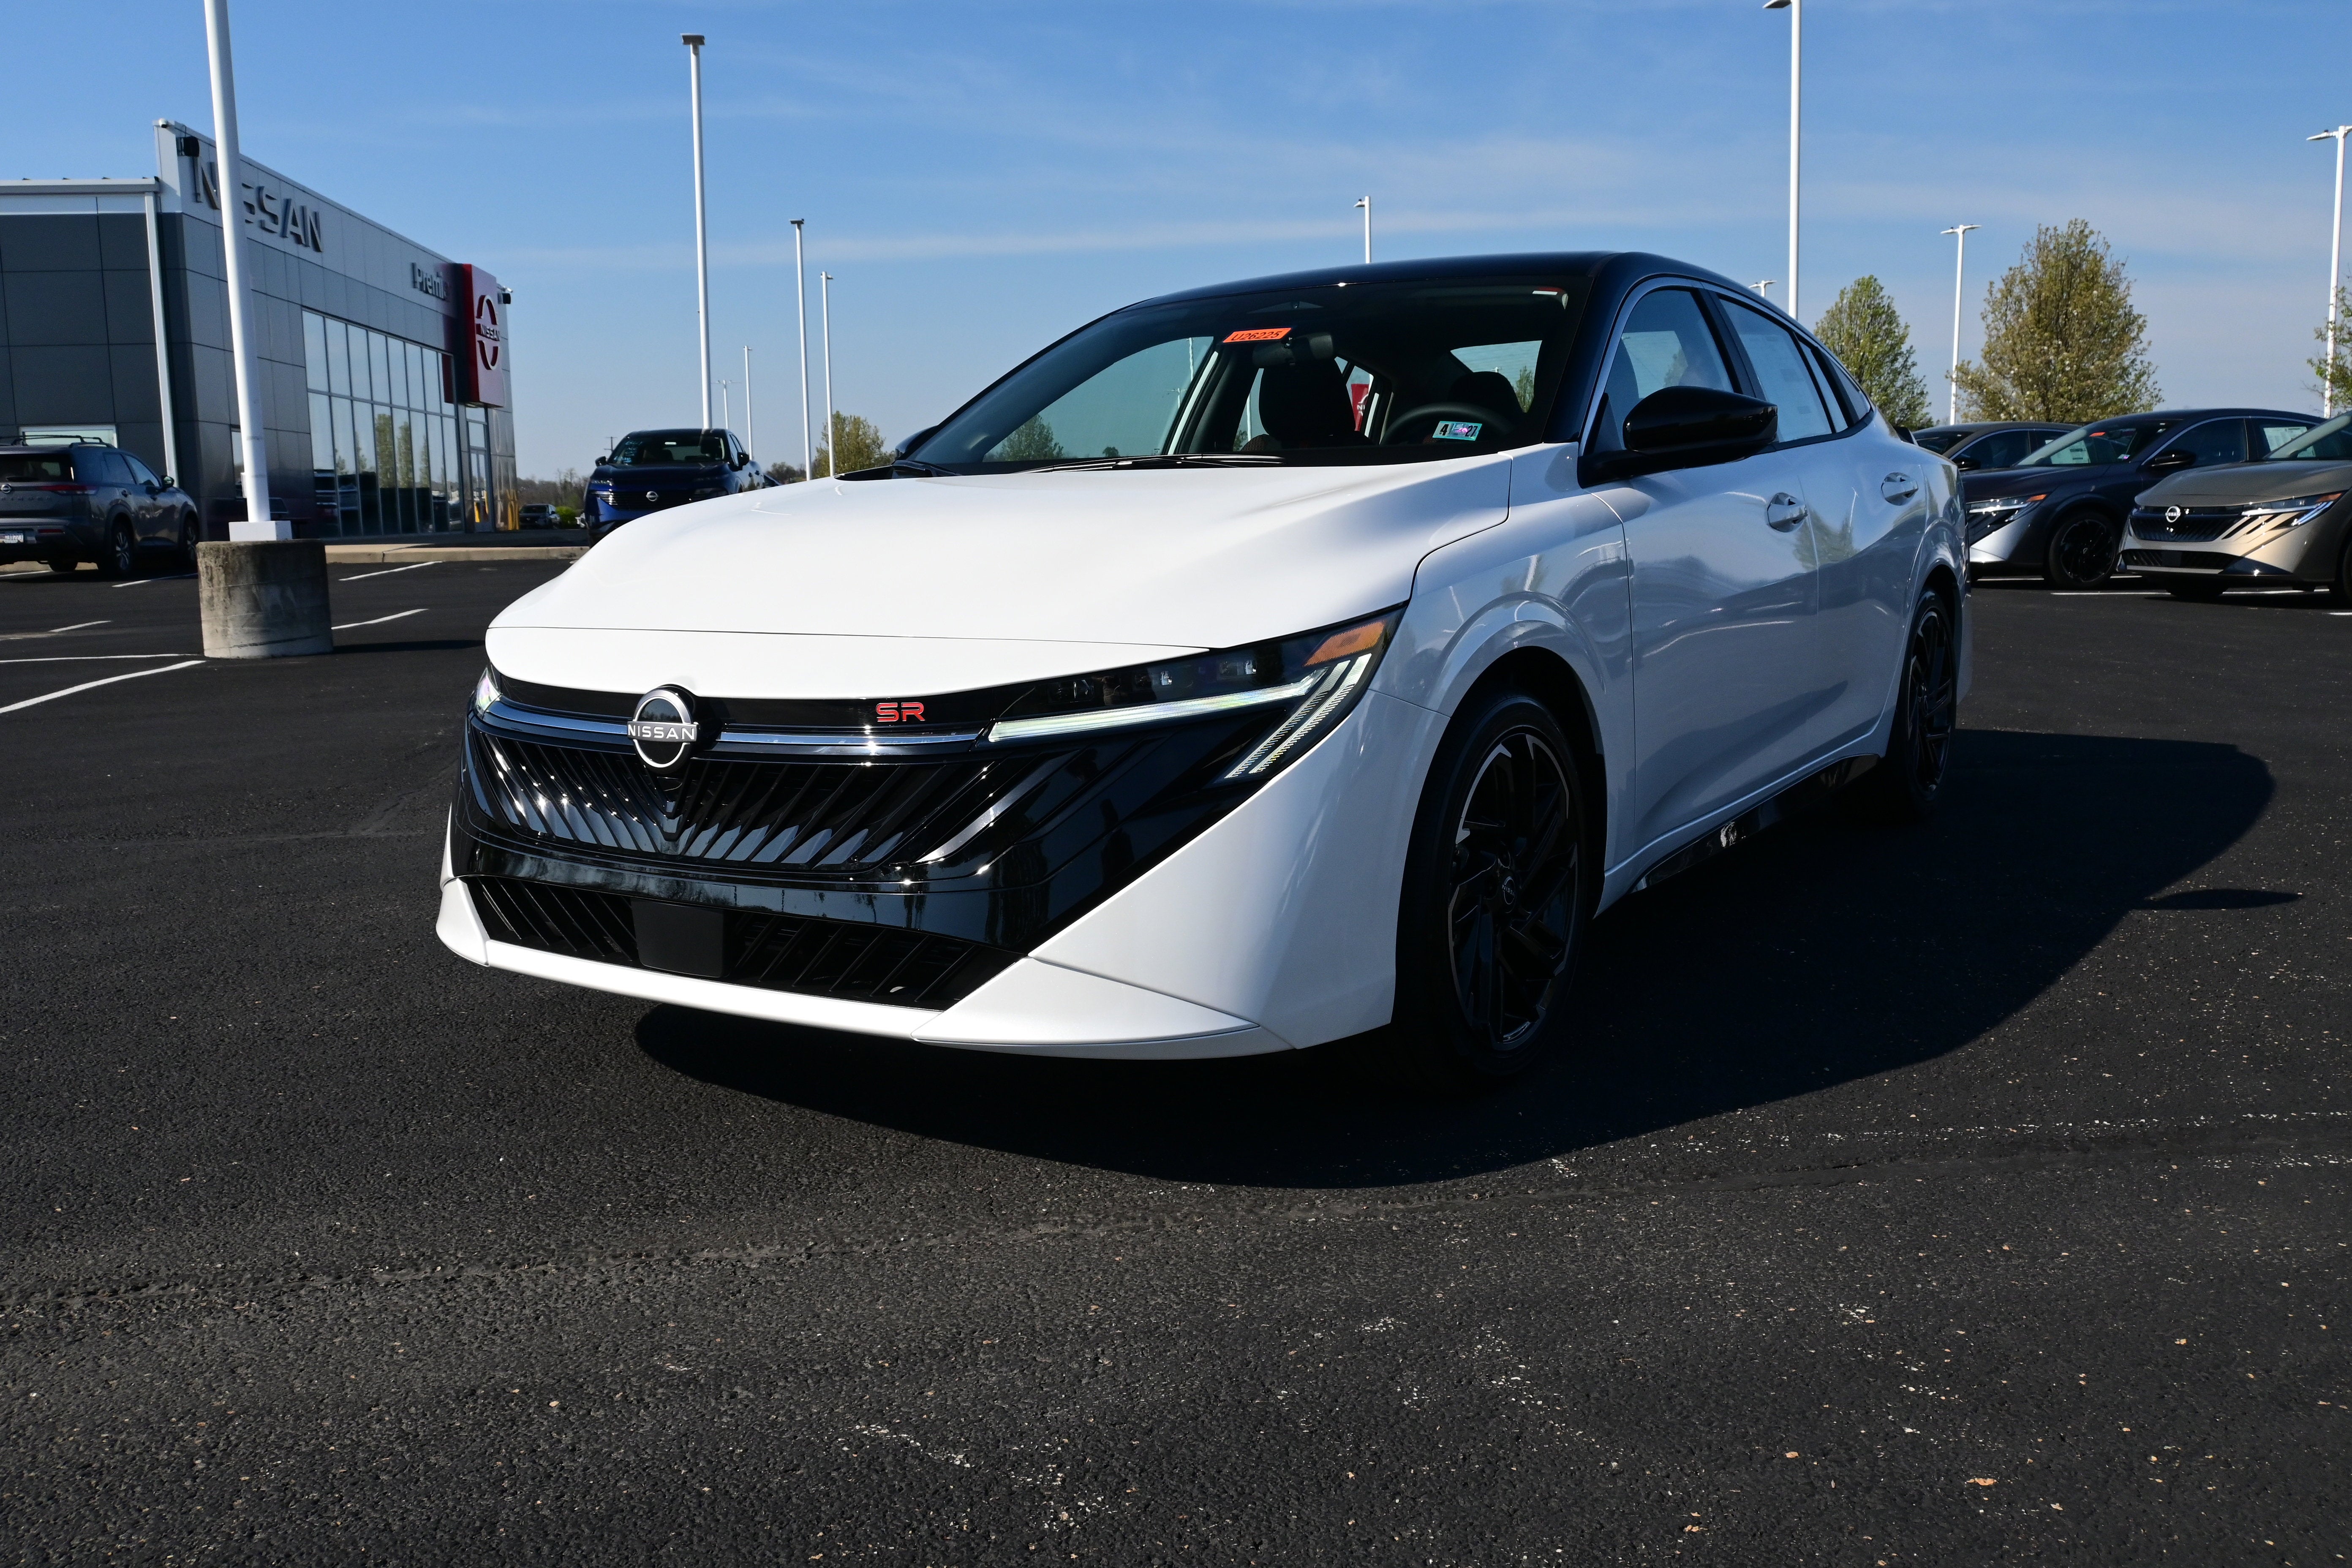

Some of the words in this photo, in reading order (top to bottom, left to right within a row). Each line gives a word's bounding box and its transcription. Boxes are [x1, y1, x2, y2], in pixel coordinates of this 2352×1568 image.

[193, 156, 323, 252] NSSAN
[411, 262, 452, 303] Premie
[481, 324, 500, 341] NISSAN
[1231, 331, 1282, 341] U26225
[1440, 424, 1449, 436] 4
[1465, 425, 1478, 437] 27
[876, 702, 926, 722] SR
[628, 724, 695, 740] NISSAN
